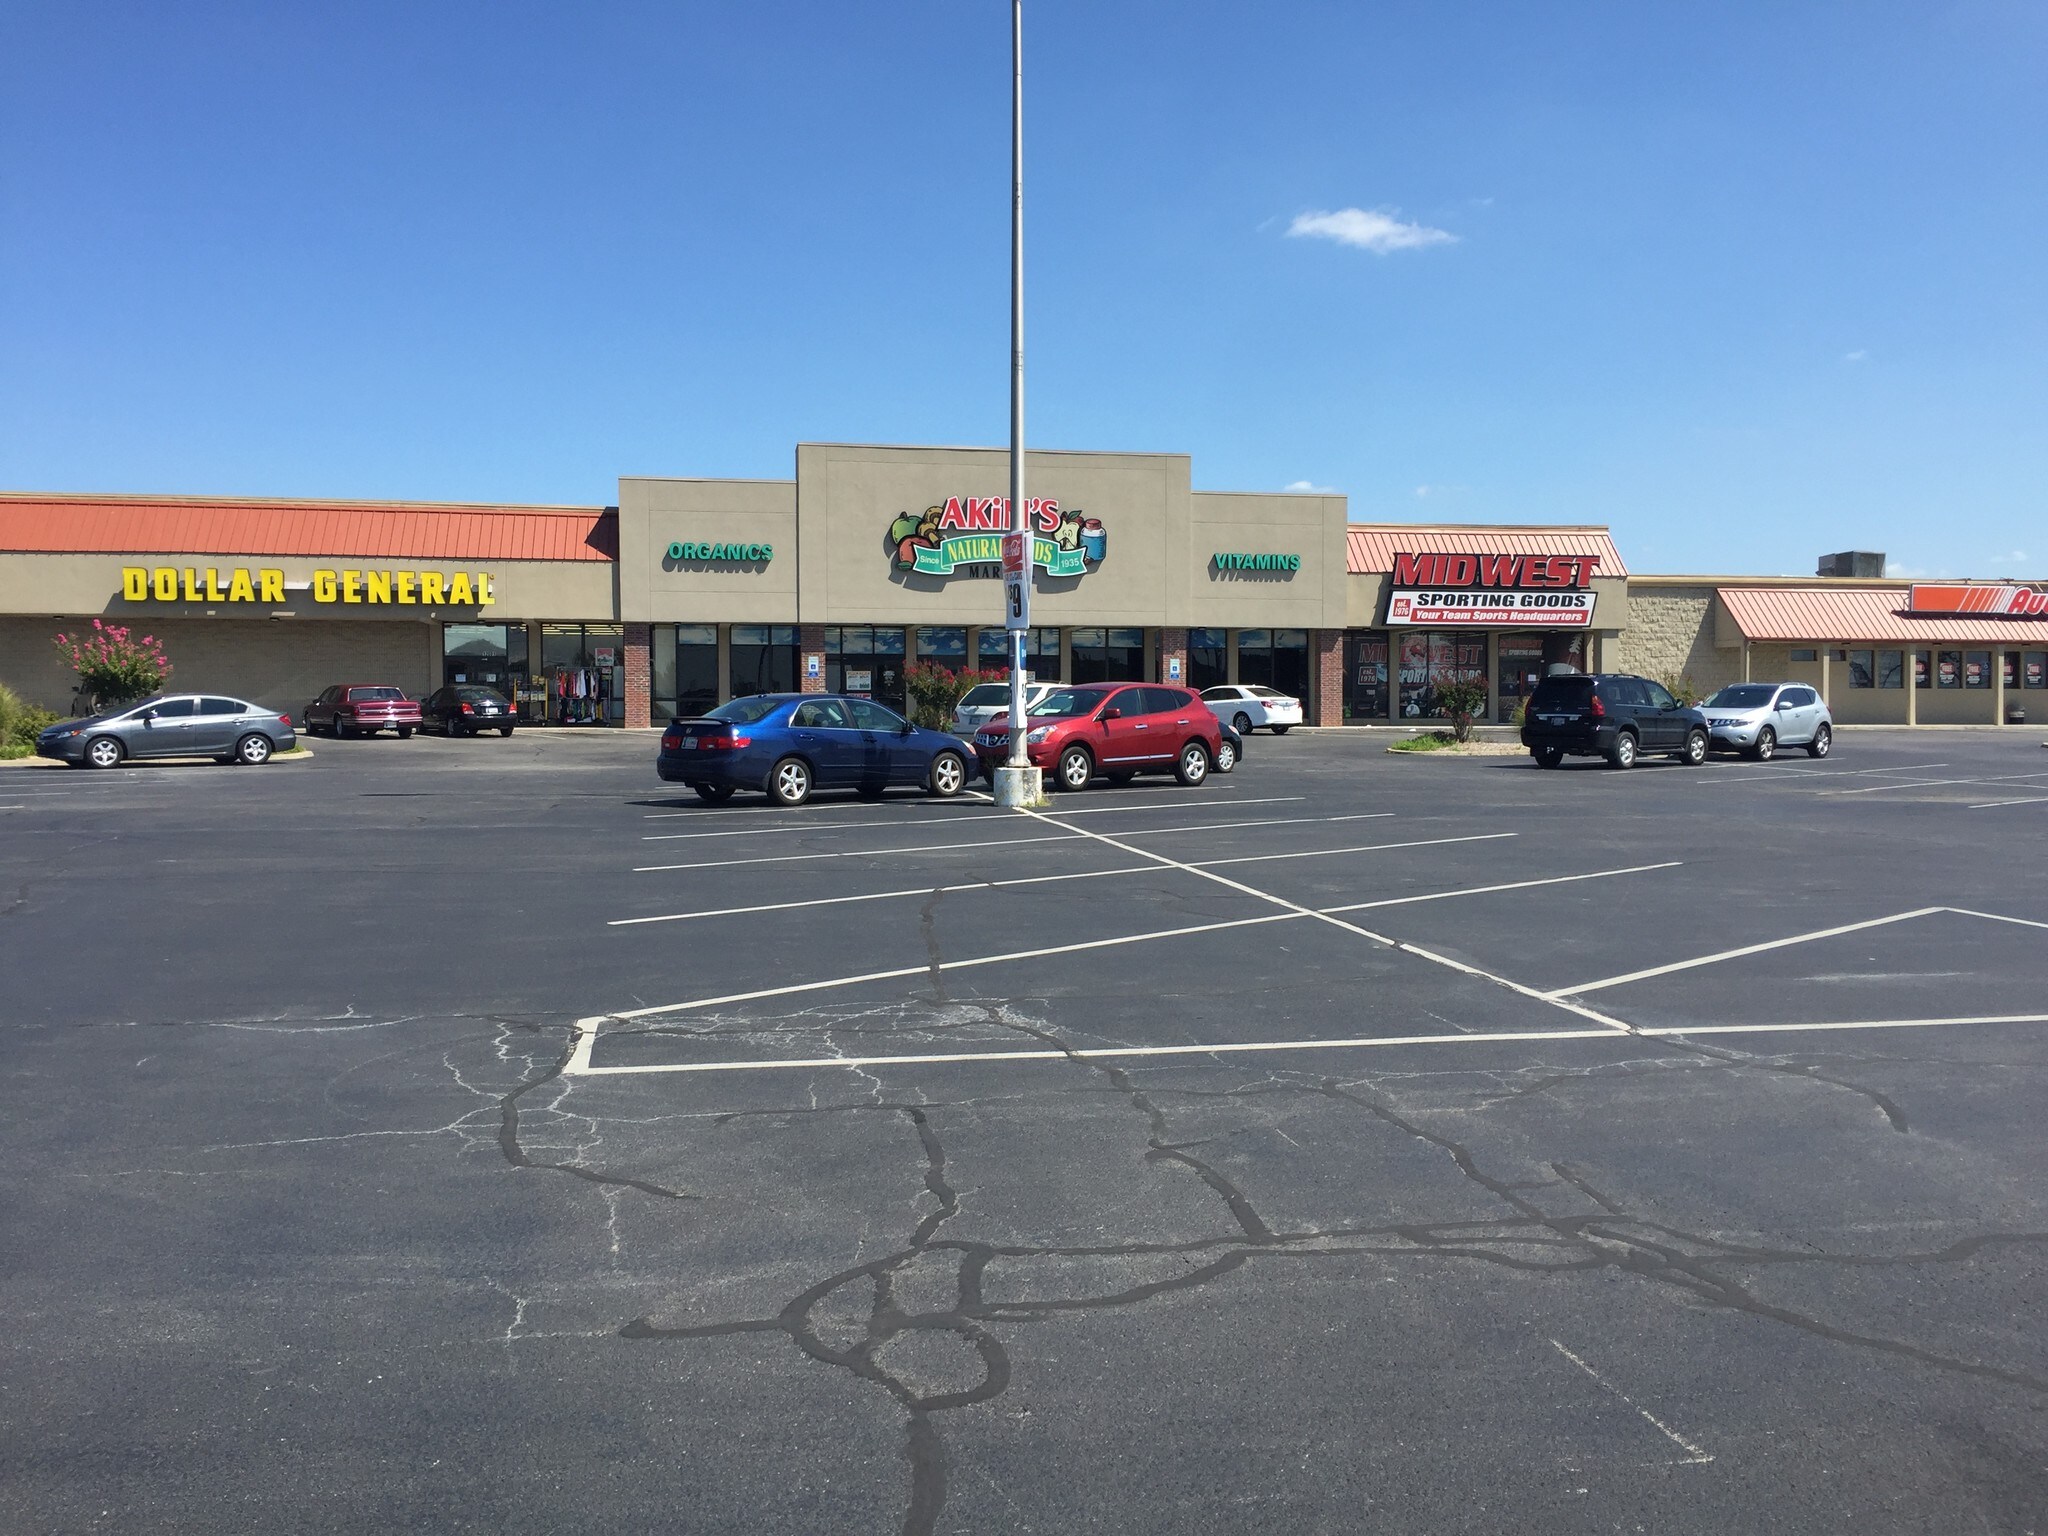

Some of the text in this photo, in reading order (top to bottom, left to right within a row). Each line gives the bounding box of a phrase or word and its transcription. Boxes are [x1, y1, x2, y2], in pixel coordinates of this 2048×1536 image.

[668, 542, 773, 561] ORGANICS
[920, 555, 940, 564] Since
[1060, 558, 1080, 568] 1935
[1215, 553, 1300, 571] VITAMINS
[1393, 553, 1600, 588] MIDWEST
[122, 567, 496, 605] DOLLAR GENERAL
[1417, 593, 1586, 608] SPORTING GOODS
[1394, 607, 1410, 616] 1976
[1416, 610, 1583, 622] Your Team Sports Headquarters
[1360, 674, 1376, 682] 1976
